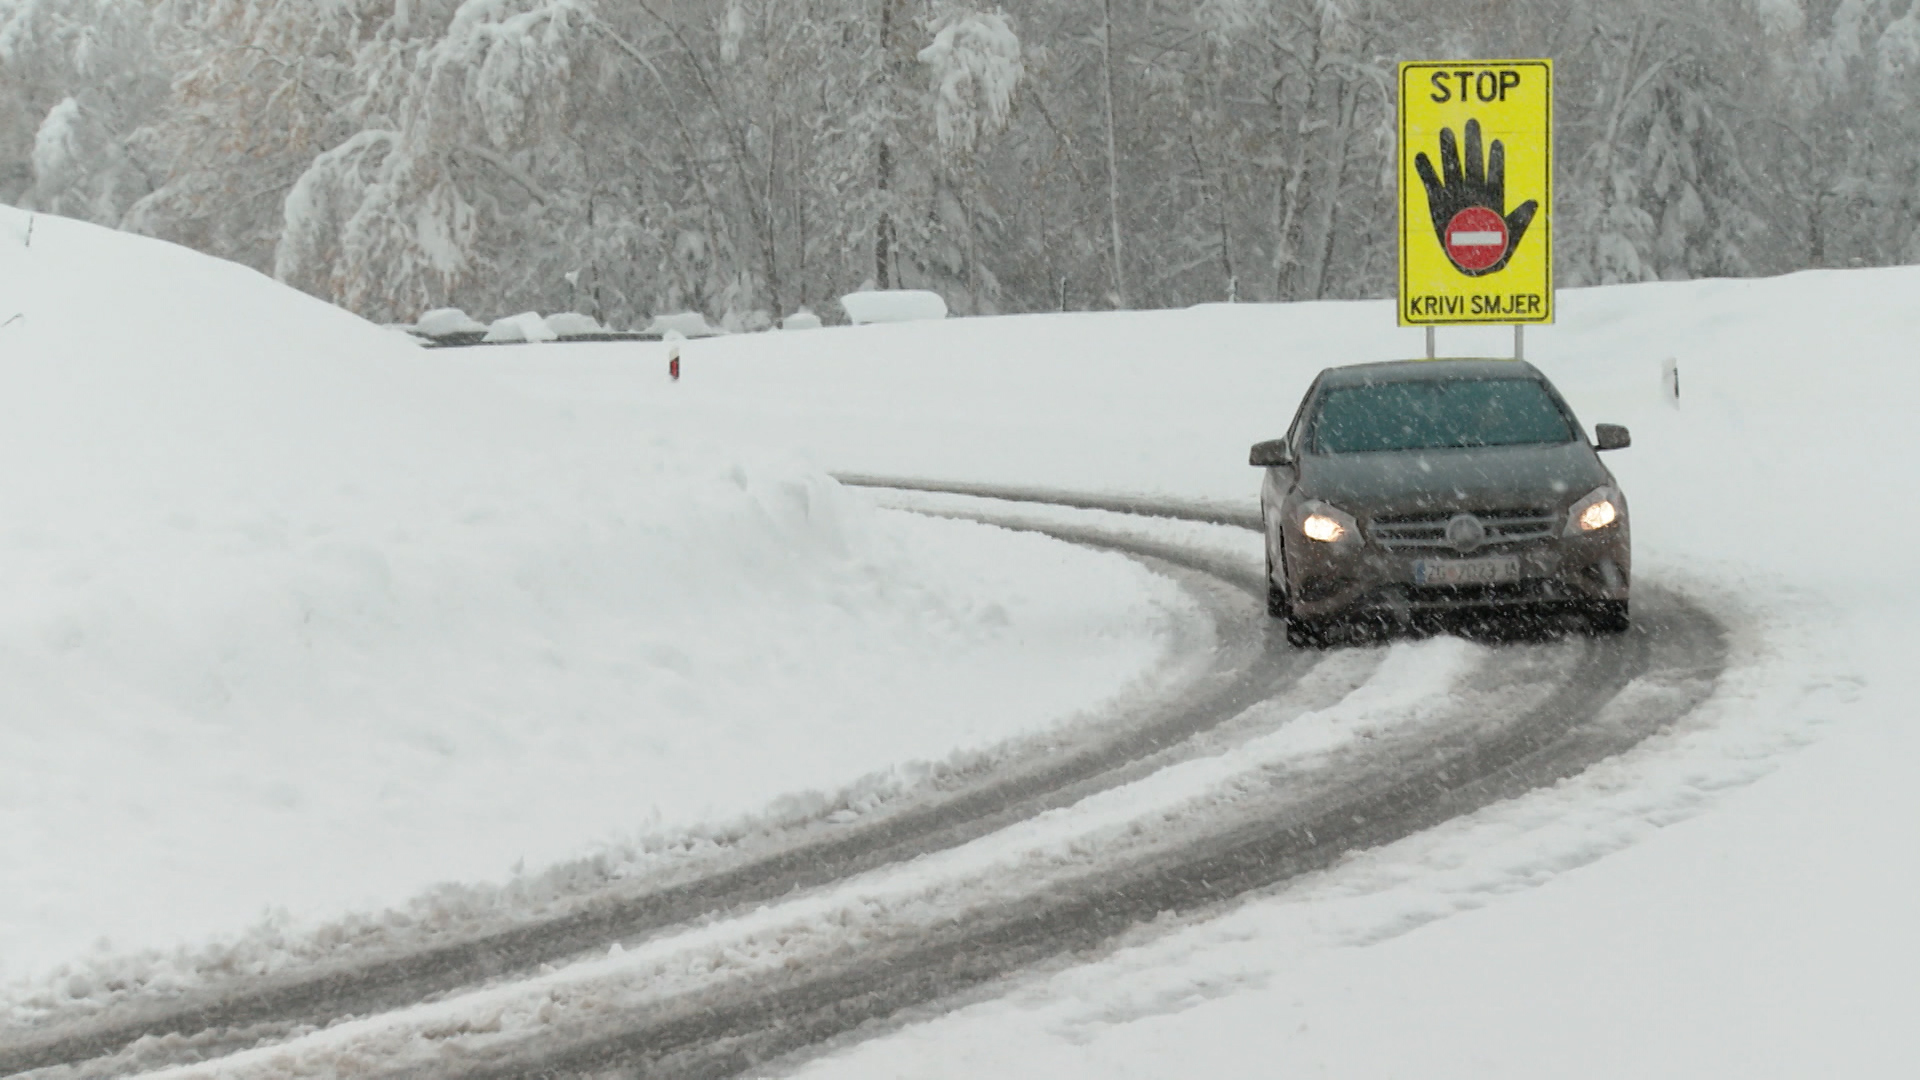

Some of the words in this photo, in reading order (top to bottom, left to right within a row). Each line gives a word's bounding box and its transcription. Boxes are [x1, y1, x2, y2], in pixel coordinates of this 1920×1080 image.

[1430, 70, 1520, 103] STOP
[1410, 295, 1464, 315] KRIVI
[1471, 293, 1541, 314] SMJER
